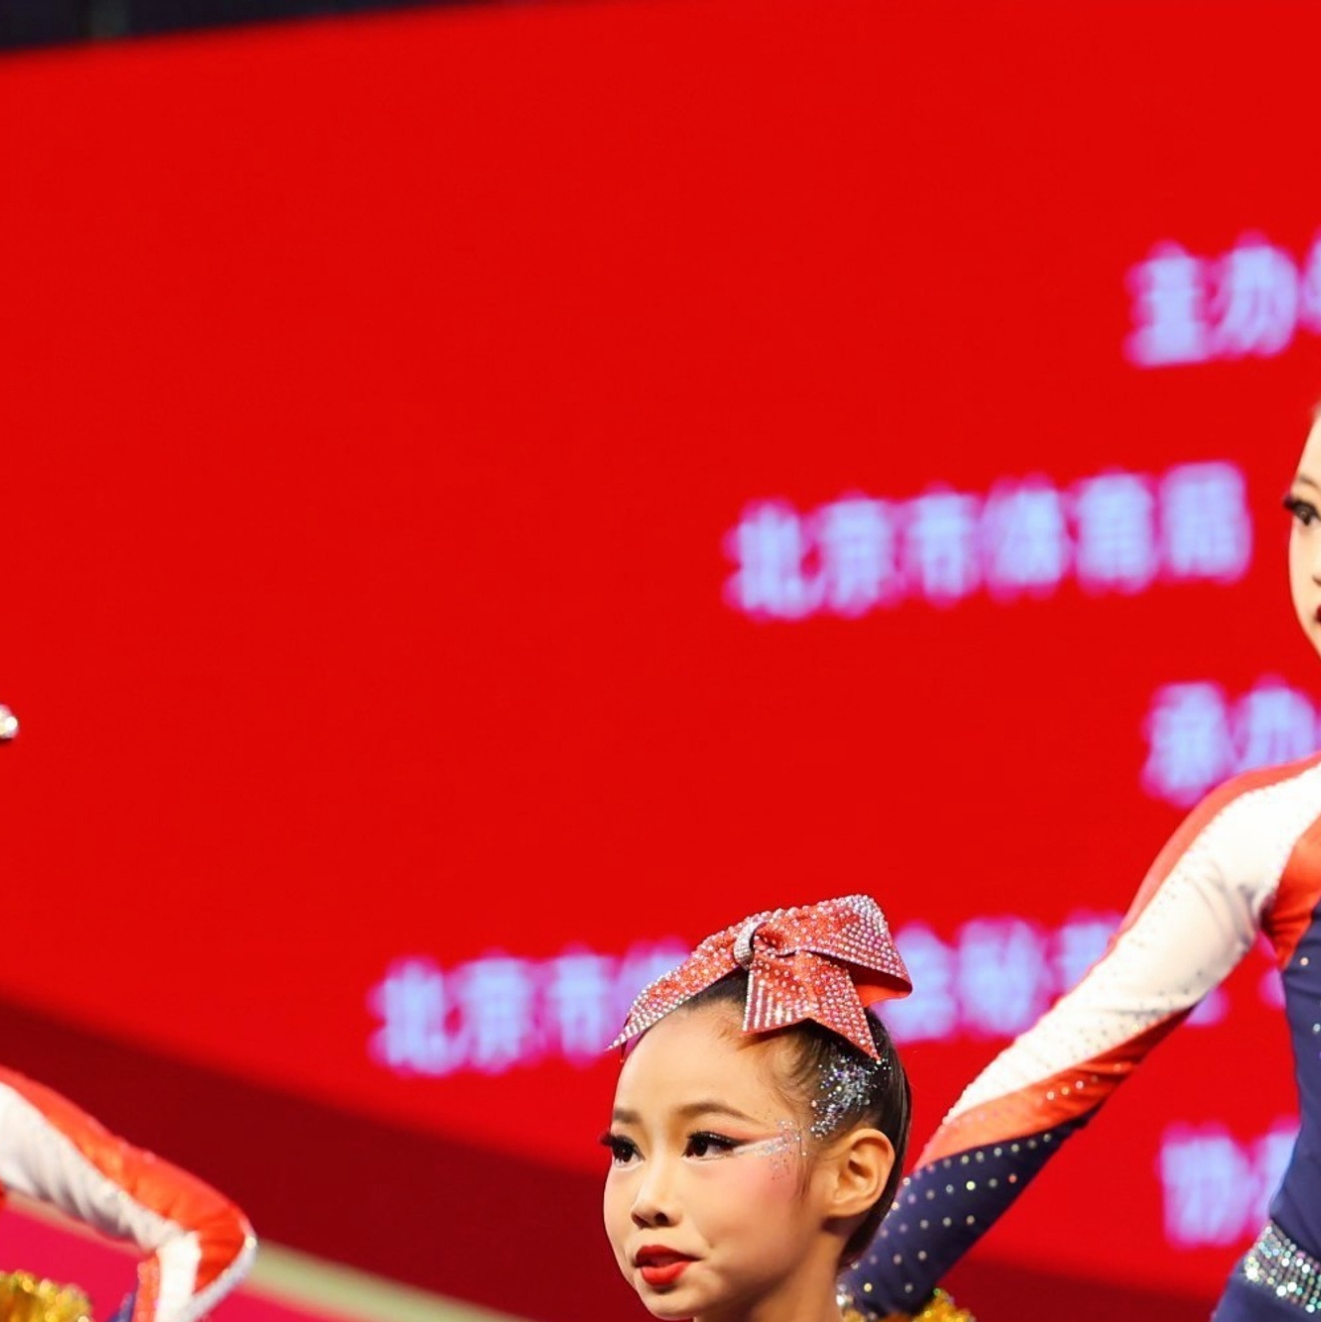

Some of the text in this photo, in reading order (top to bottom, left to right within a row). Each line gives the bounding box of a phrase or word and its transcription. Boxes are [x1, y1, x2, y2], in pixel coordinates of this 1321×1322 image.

[724, 460, 1250, 618] 北京市体育局
